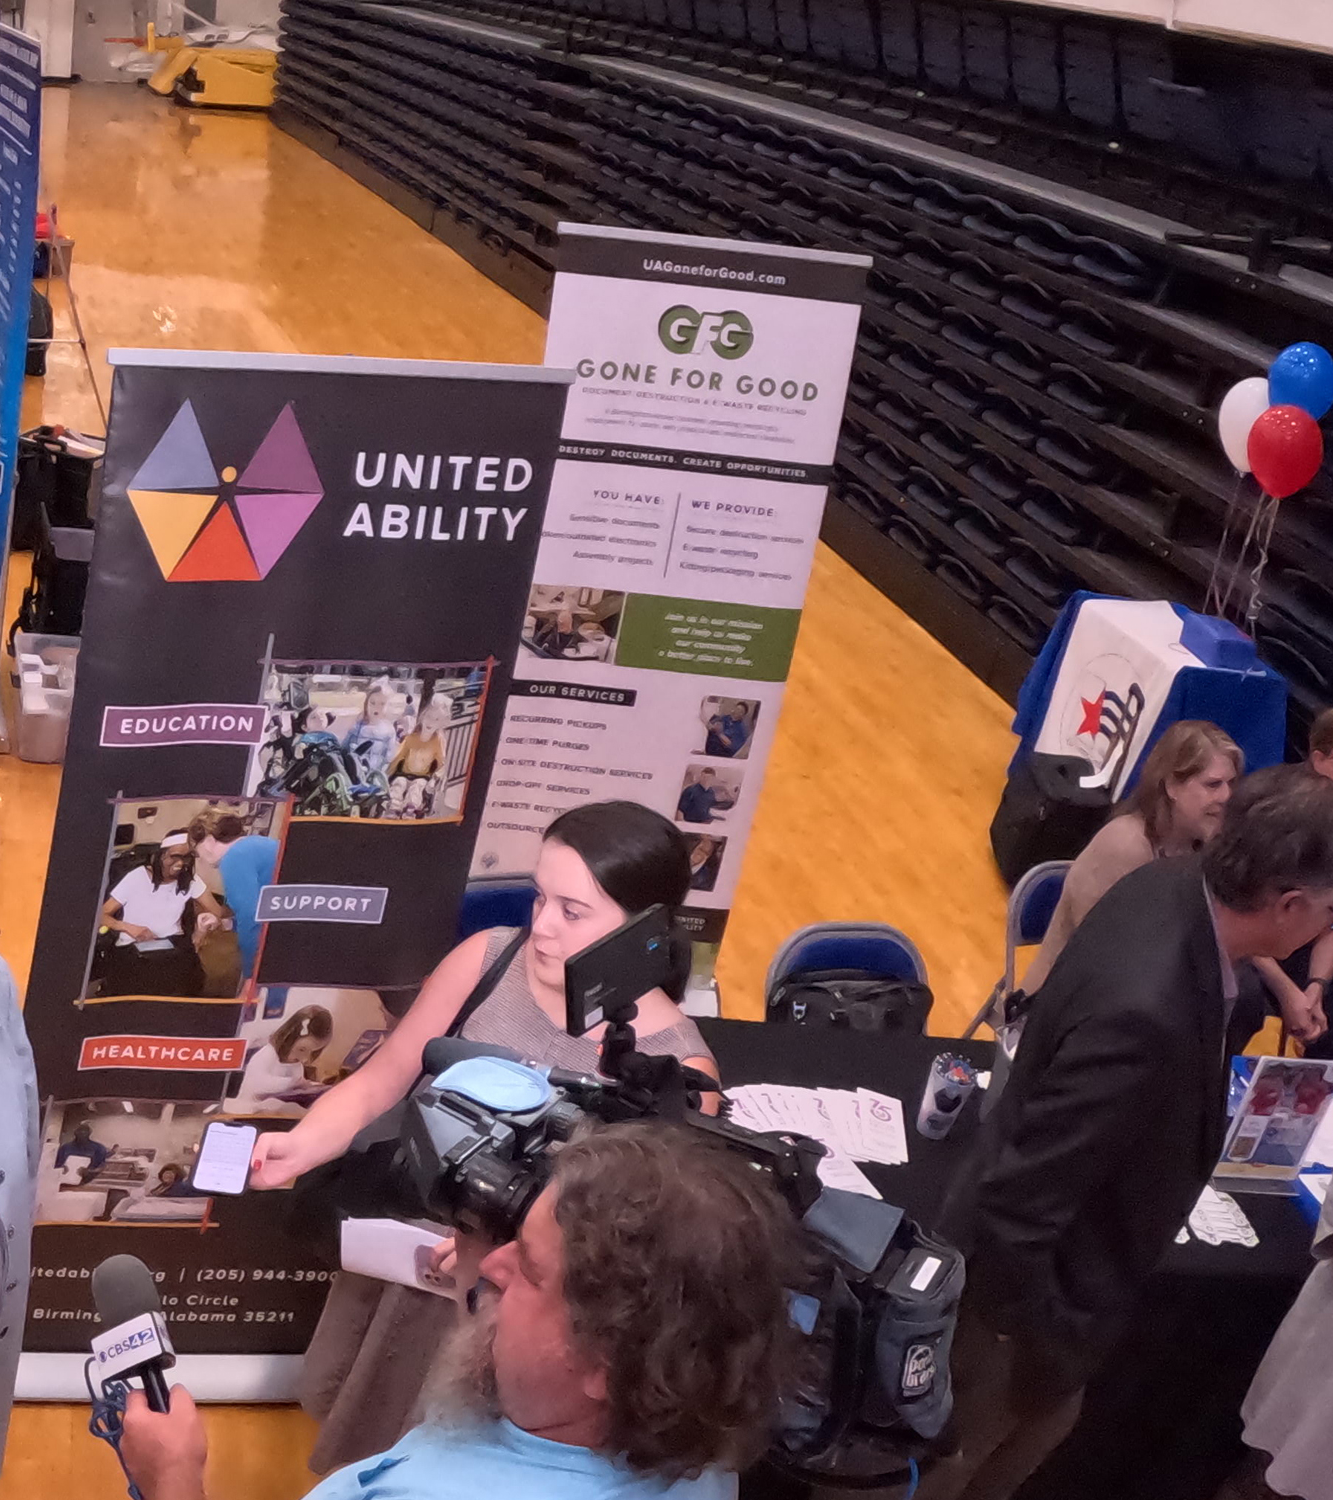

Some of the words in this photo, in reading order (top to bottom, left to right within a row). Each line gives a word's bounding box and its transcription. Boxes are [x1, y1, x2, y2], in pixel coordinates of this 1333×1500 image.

[643, 258, 786, 286] UAGoneforGood.com
[576, 358, 658, 385] GONE
[670, 367, 724, 392] FOR
[735, 374, 819, 402] GOOD
[559, 445, 606, 457] DESTROY
[683, 457, 722, 469] CREATE
[355, 451, 533, 492] UNITED
[593, 489, 620, 501] YOU
[691, 499, 710, 511] WE
[342, 502, 528, 541] ABILITY
[529, 684, 557, 695] OUR
[561, 687, 625, 702] SERVICES
[119, 715, 254, 735] EDUCATION
[487, 822, 545, 834] OUTSOURCE
[270, 895, 373, 912] SUPPORT
[91, 1045, 234, 1061] HEALTHCARE
[196, 1268, 245, 1283] (205)
[186, 1294, 239, 1306] Circle
[32, 1308, 102, 1323] Birming
[243, 1311, 294, 1323] 35211
